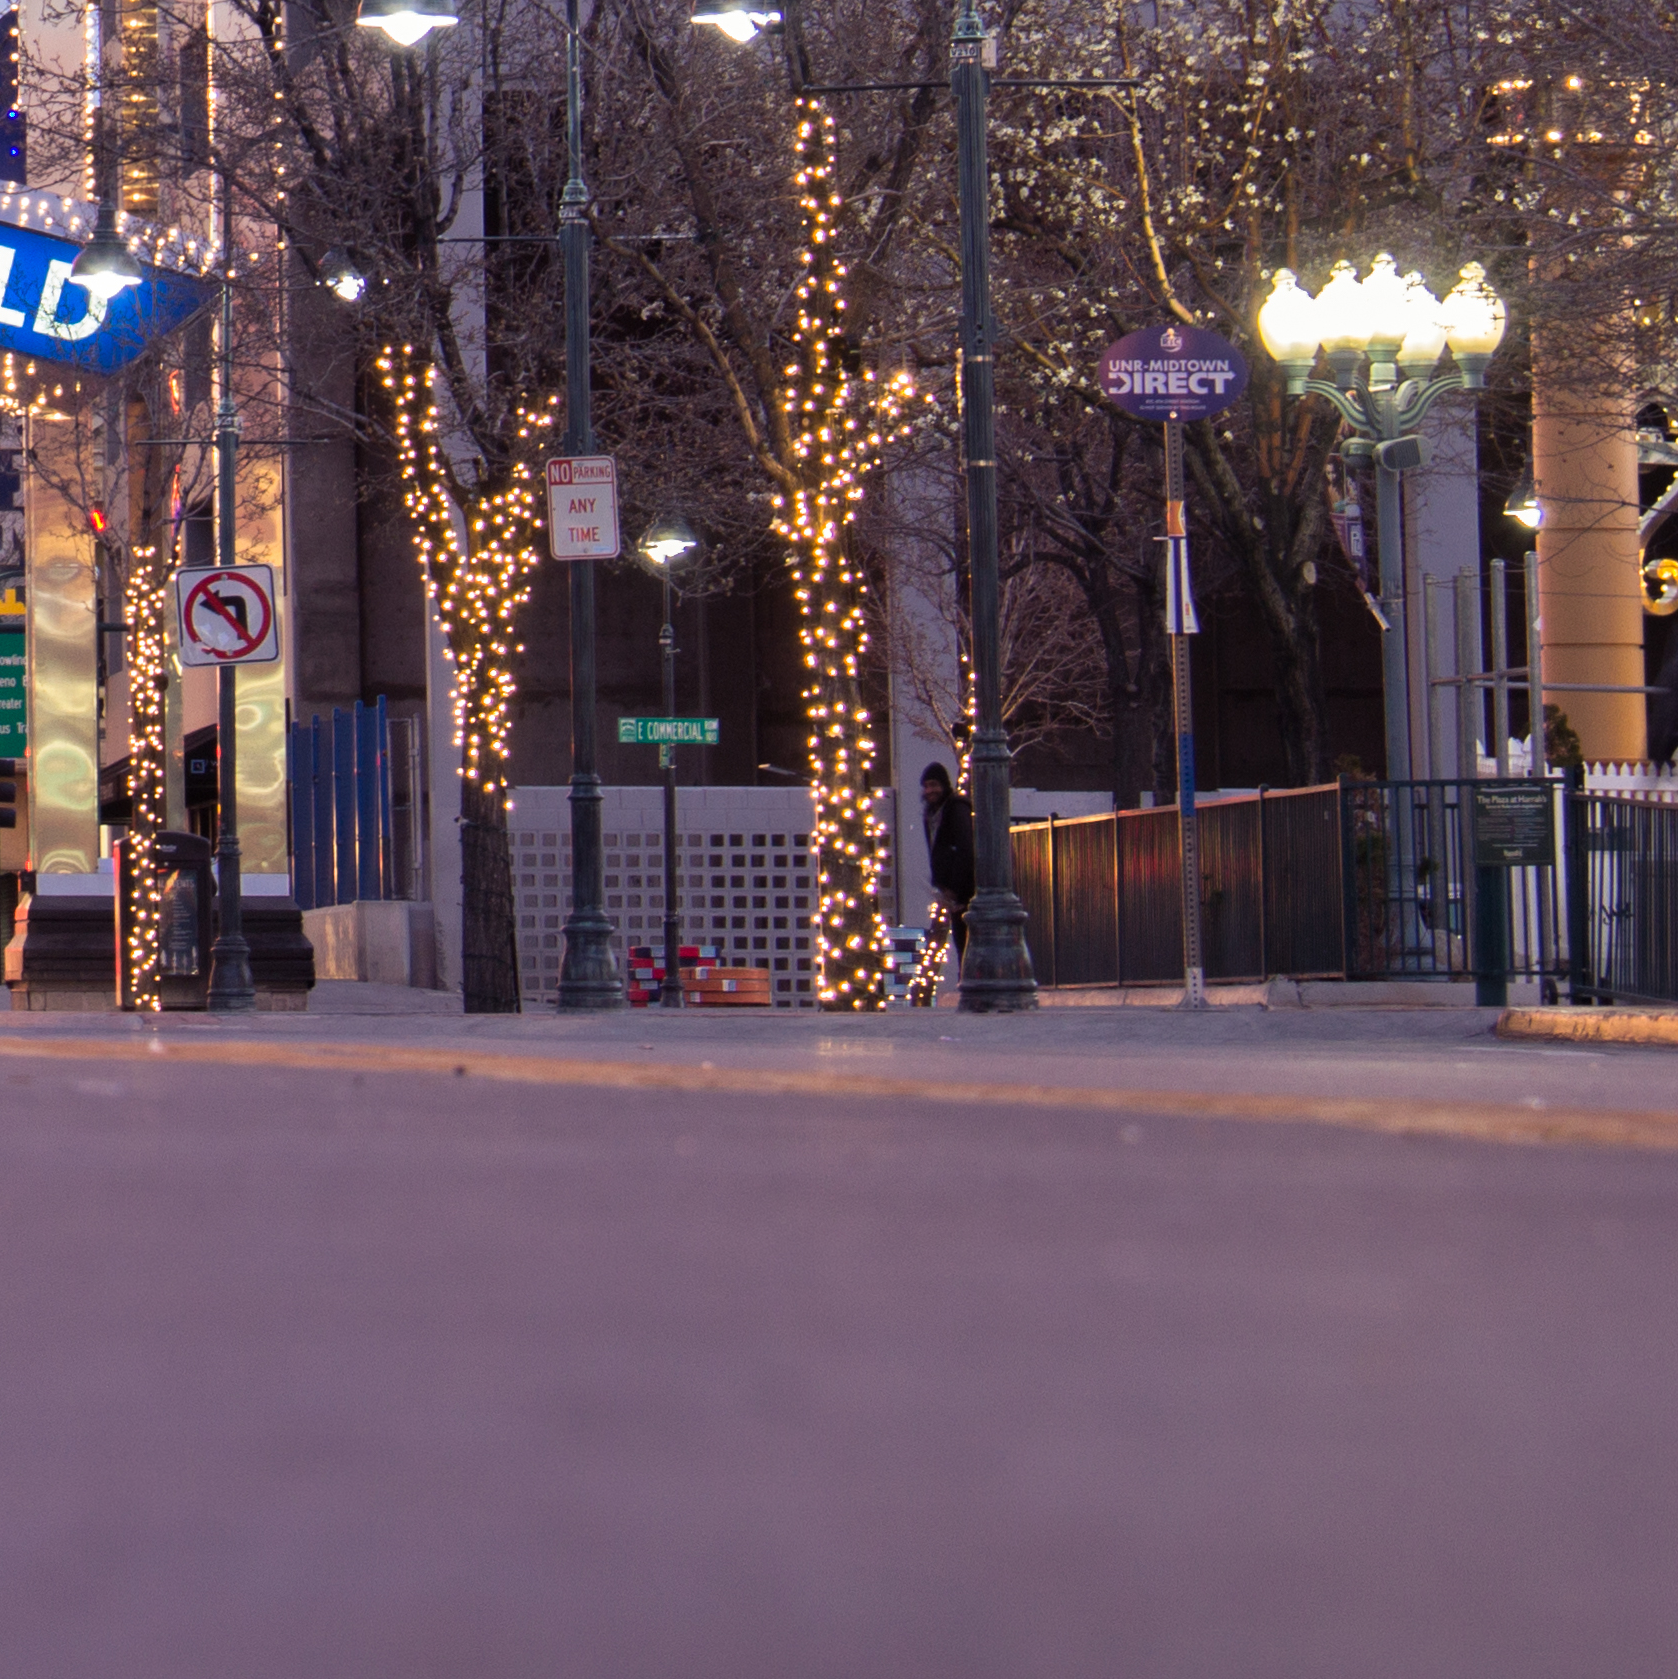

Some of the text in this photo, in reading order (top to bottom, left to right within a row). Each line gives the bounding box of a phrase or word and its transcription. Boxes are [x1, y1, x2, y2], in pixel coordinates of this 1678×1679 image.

[1109, 359, 1229, 372] UNR-MIDTOWN
[1108, 372, 1236, 395] DIRECT
[550, 463, 611, 483] NO PARKING
[568, 498, 596, 514] ANY
[568, 526, 600, 542] TIME
[647, 722, 703, 740] COMMERCIAL
